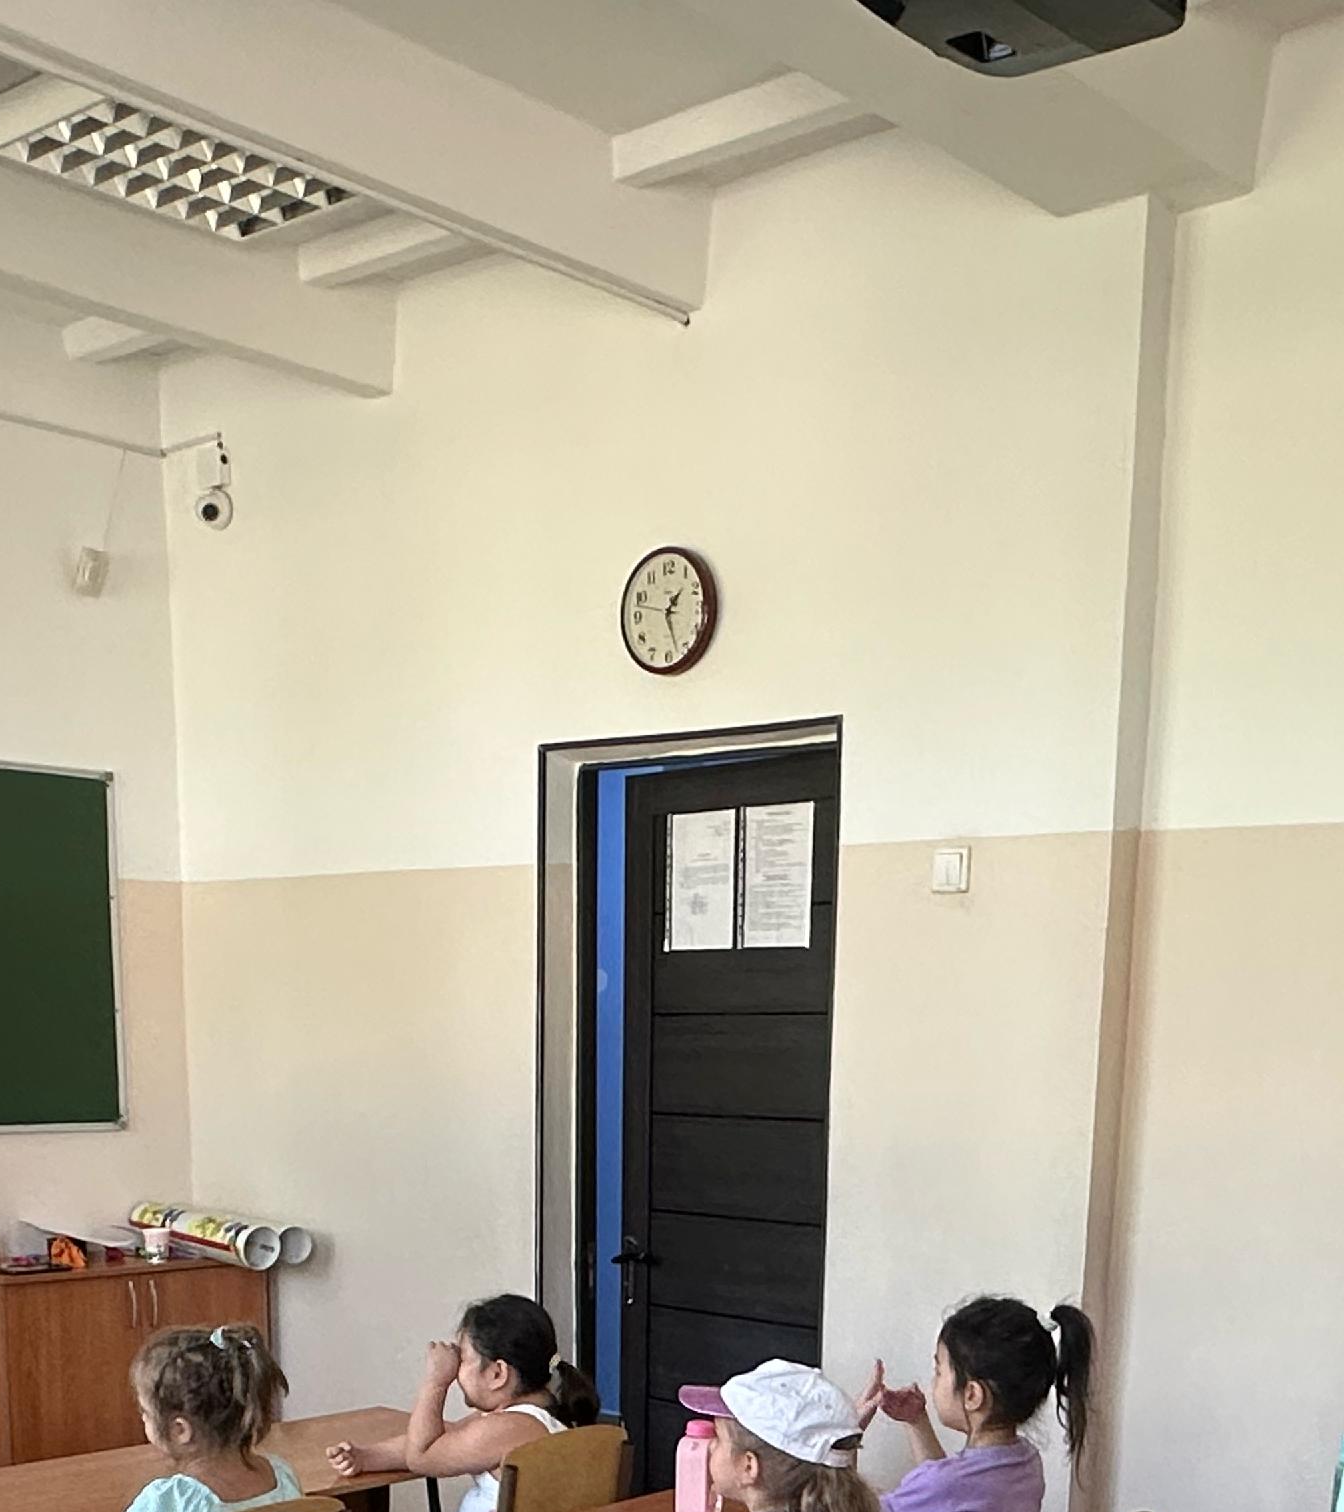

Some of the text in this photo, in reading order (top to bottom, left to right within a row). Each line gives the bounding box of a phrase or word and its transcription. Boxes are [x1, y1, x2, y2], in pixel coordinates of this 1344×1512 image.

[663, 559, 675, 576] 12
[684, 565, 688, 579] 1
[647, 571, 655, 585] 11
[691, 582, 700, 596] 2
[637, 590, 647, 605] 10
[634, 611, 642, 625] 9
[639, 632, 646, 644] 8
[648, 647, 656, 661] 7
[665, 650, 673, 664] 6
